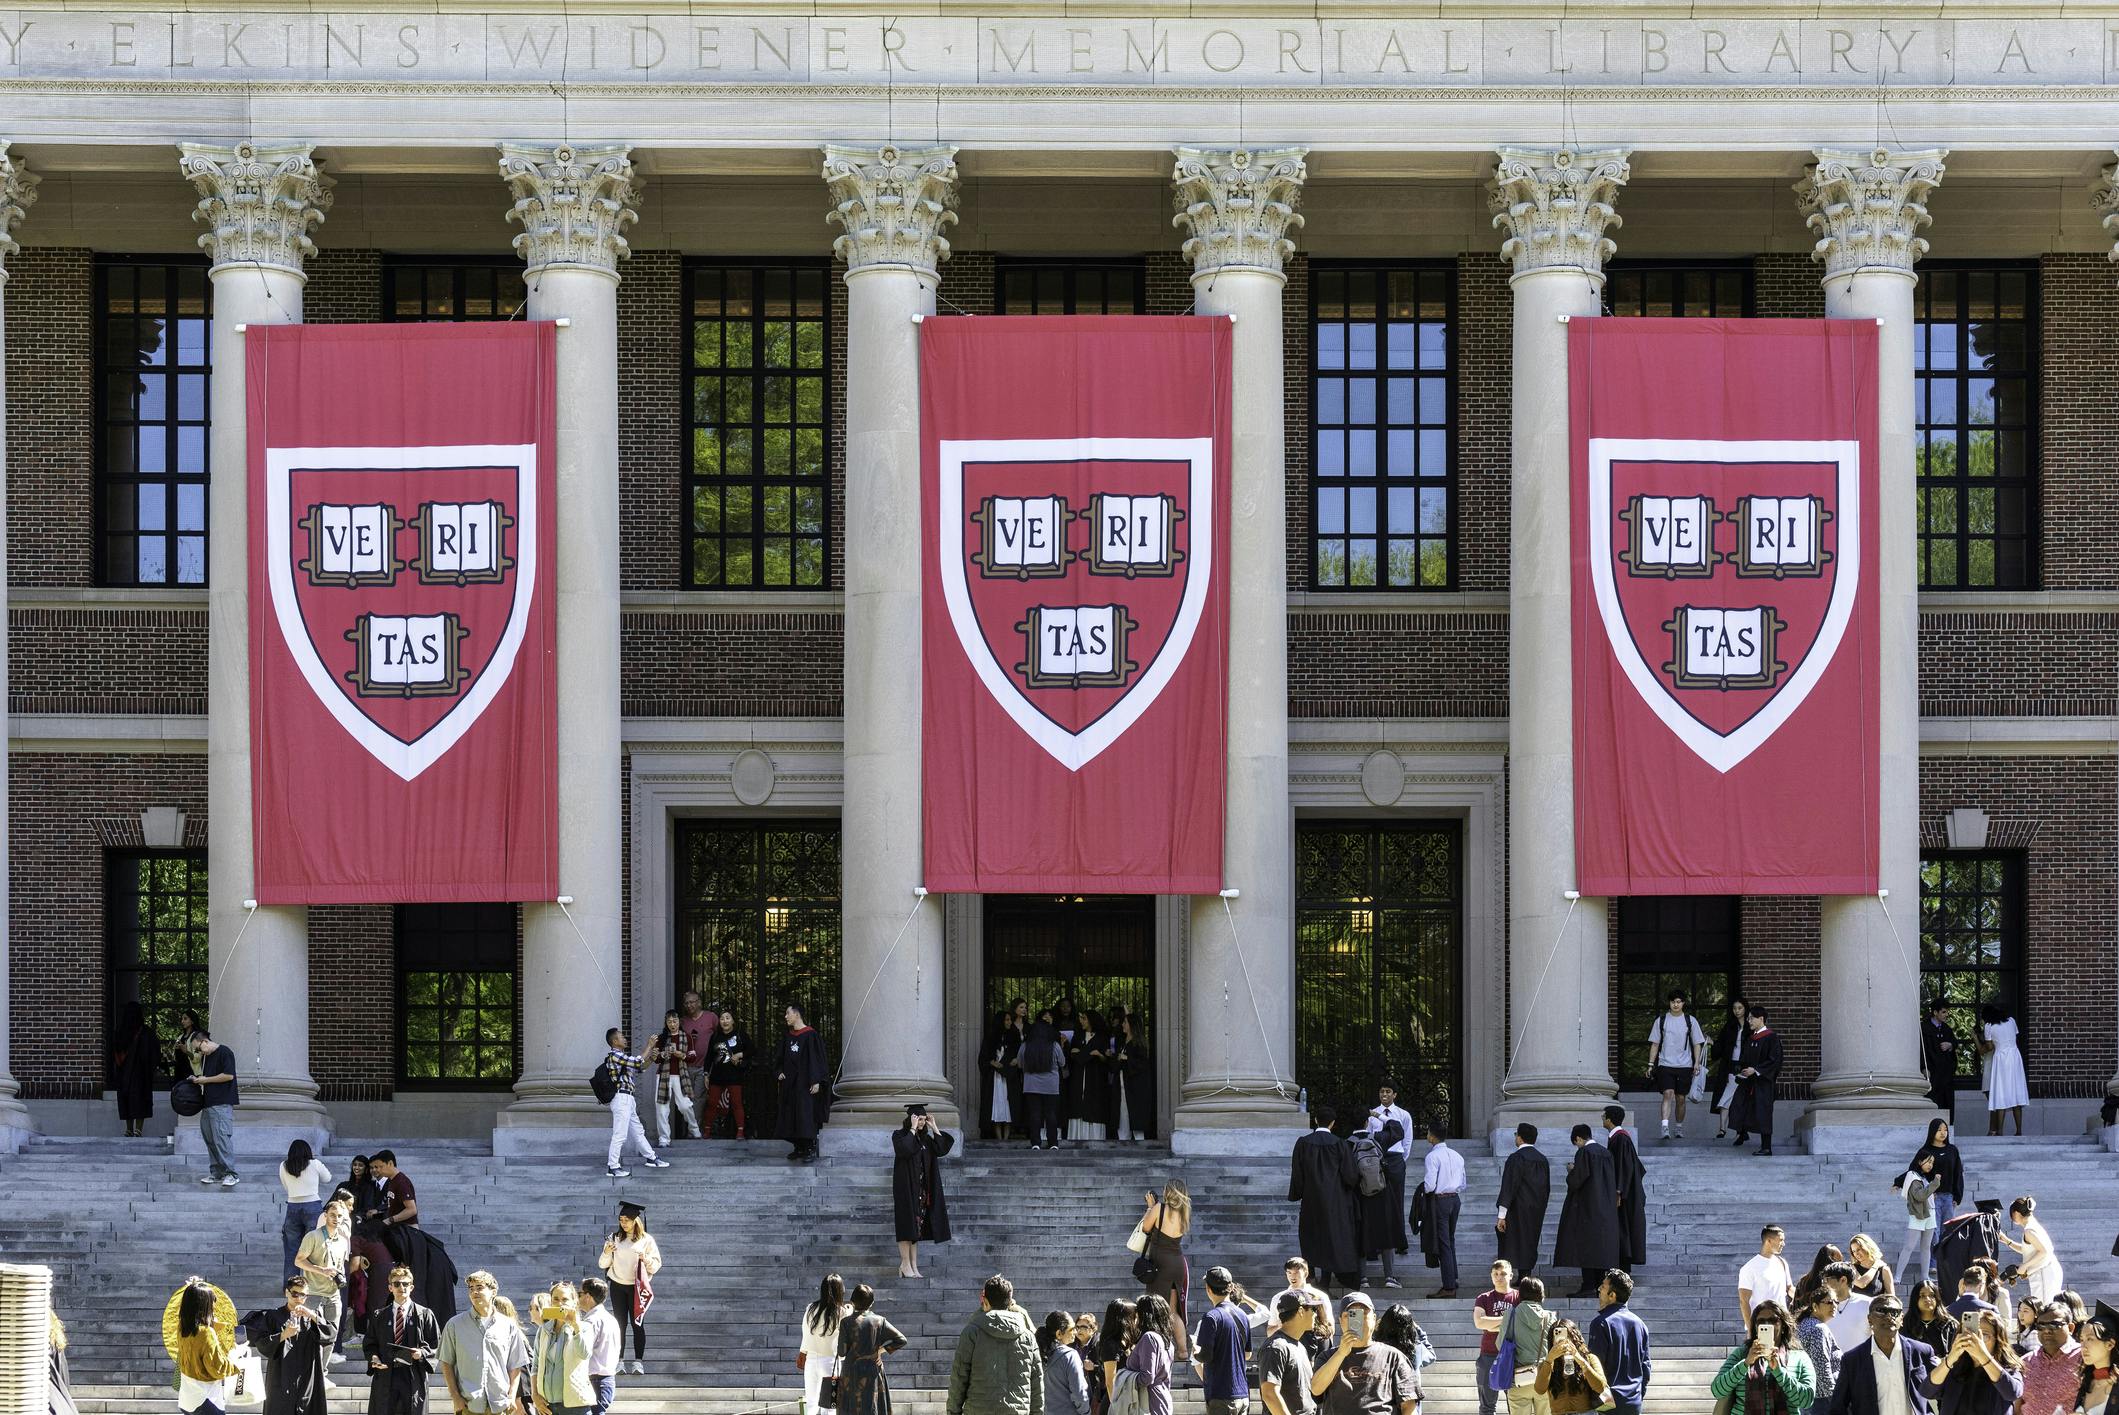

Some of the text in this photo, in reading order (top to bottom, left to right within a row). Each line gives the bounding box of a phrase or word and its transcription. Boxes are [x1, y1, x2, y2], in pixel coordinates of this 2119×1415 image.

[0, 21, 2038, 75] Y ELKINS WIDENER MEMORIAL LIBRARY A
[324, 523, 478, 556] VE RI
[997, 515, 1148, 549] VE RI
[1644, 517, 1797, 549] VE RI
[377, 633, 439, 665] TAS
[1047, 625, 1107, 656] TAS
[1694, 625, 1755, 658] TAS
